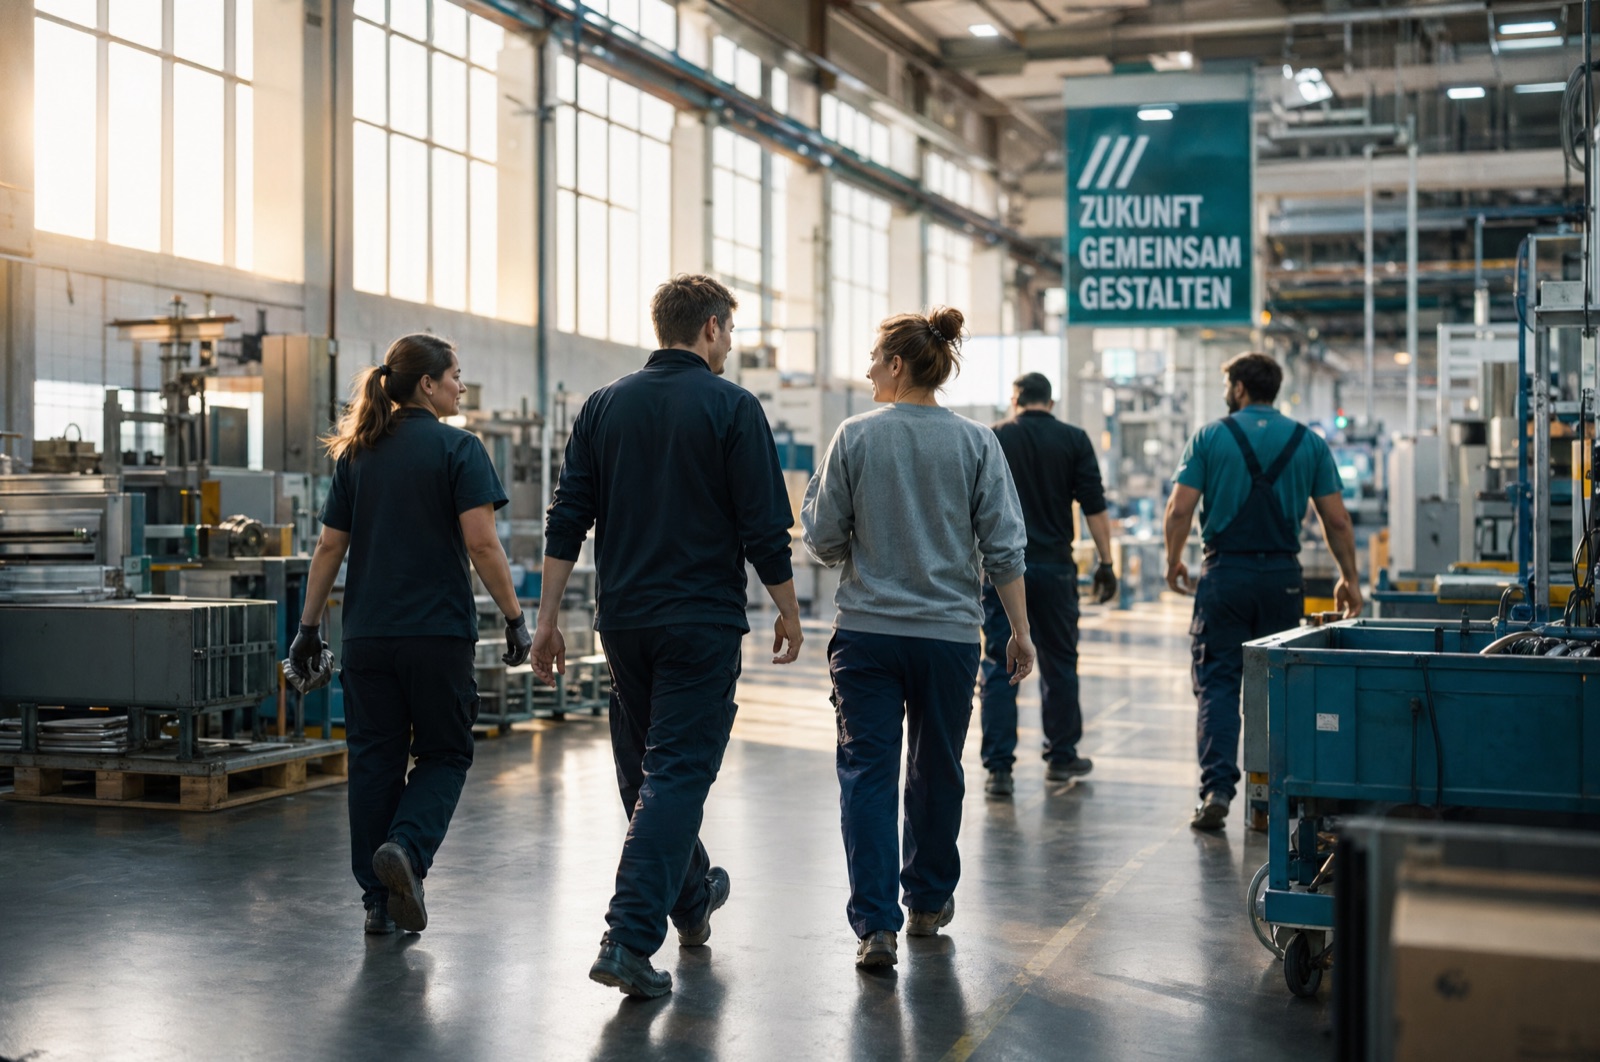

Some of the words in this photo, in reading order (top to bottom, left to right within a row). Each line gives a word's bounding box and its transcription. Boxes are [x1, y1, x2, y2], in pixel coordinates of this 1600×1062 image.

[1079, 195, 1203, 228] ZUKUNFT
[1079, 237, 1241, 269] GEMEINSAM
[1079, 277, 1232, 309] GESTALTEN
